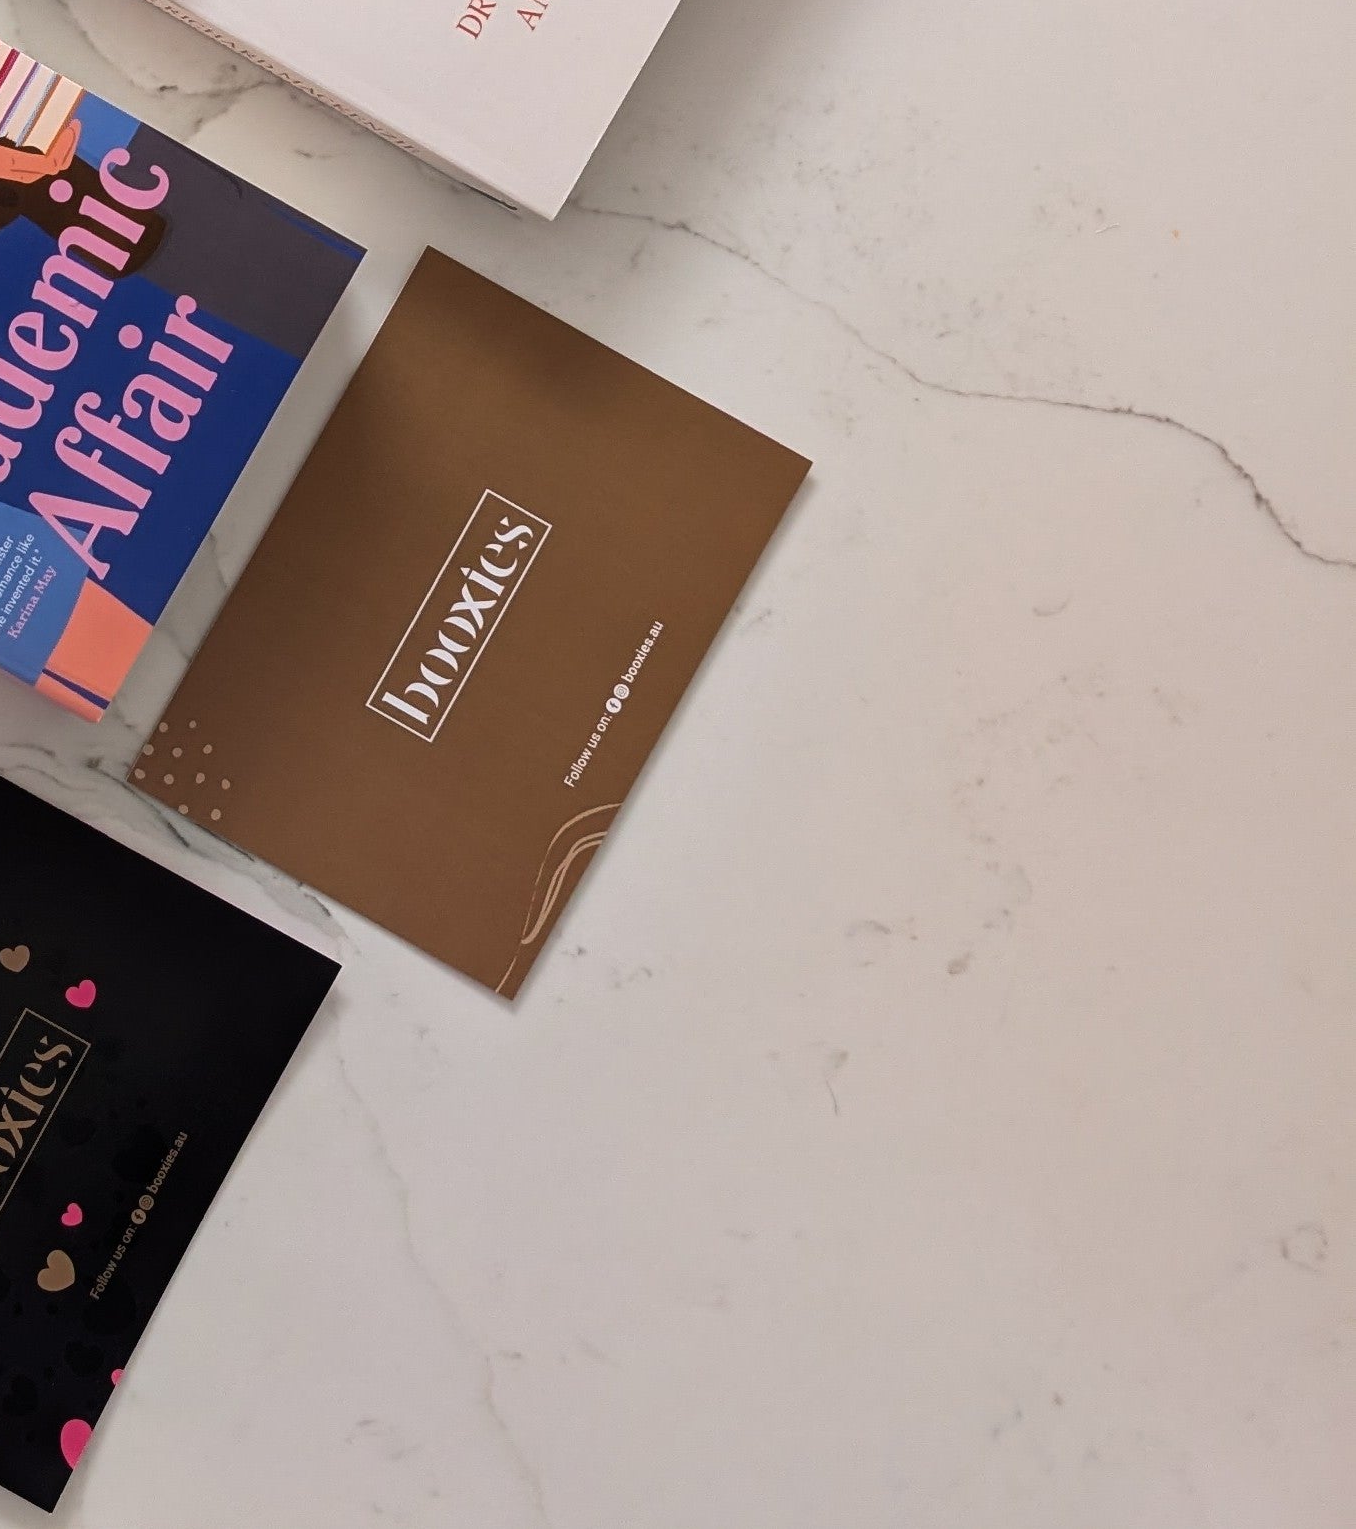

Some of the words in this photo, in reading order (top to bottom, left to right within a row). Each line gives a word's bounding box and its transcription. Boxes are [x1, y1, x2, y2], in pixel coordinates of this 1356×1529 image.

[28, 294, 234, 580] Affair
[381, 516, 534, 725] booxies
[563, 747, 593, 788] Follow
[587, 732, 602, 749] us
[596, 711, 614, 733] on:
[620, 620, 664, 683] booxies.au
